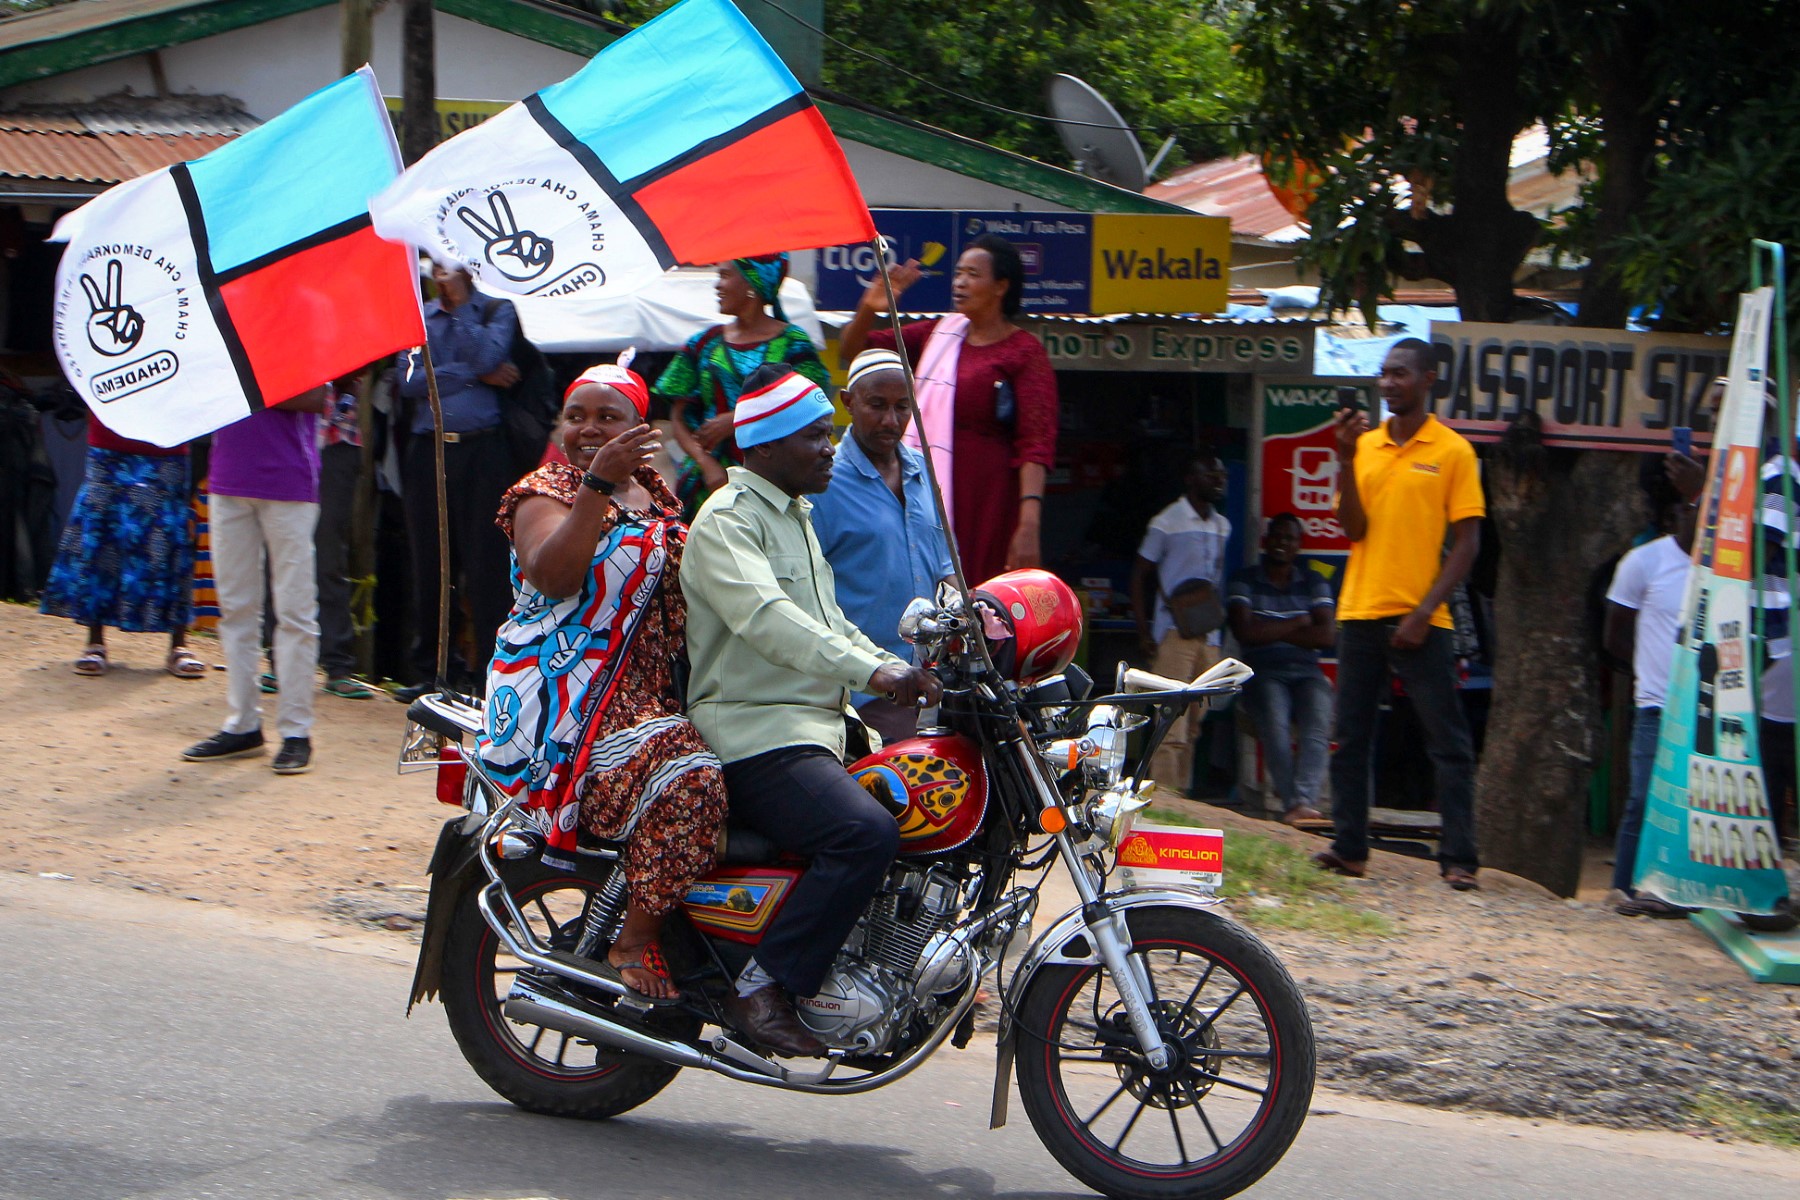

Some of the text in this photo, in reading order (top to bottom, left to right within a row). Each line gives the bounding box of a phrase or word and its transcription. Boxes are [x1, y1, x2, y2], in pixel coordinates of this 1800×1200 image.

[1103, 247, 1222, 280] Wakala
[1040, 325, 1304, 369] hoTo Express
[1266, 388, 1370, 407] WAKAA
[1431, 332, 1634, 427] PASSPORT
[1640, 345, 1732, 432] SIZ
[1160, 848, 1219, 861] KINGLION
[799, 998, 841, 1011] KINGLION
[1115, 967, 1149, 1032] KINGLION
